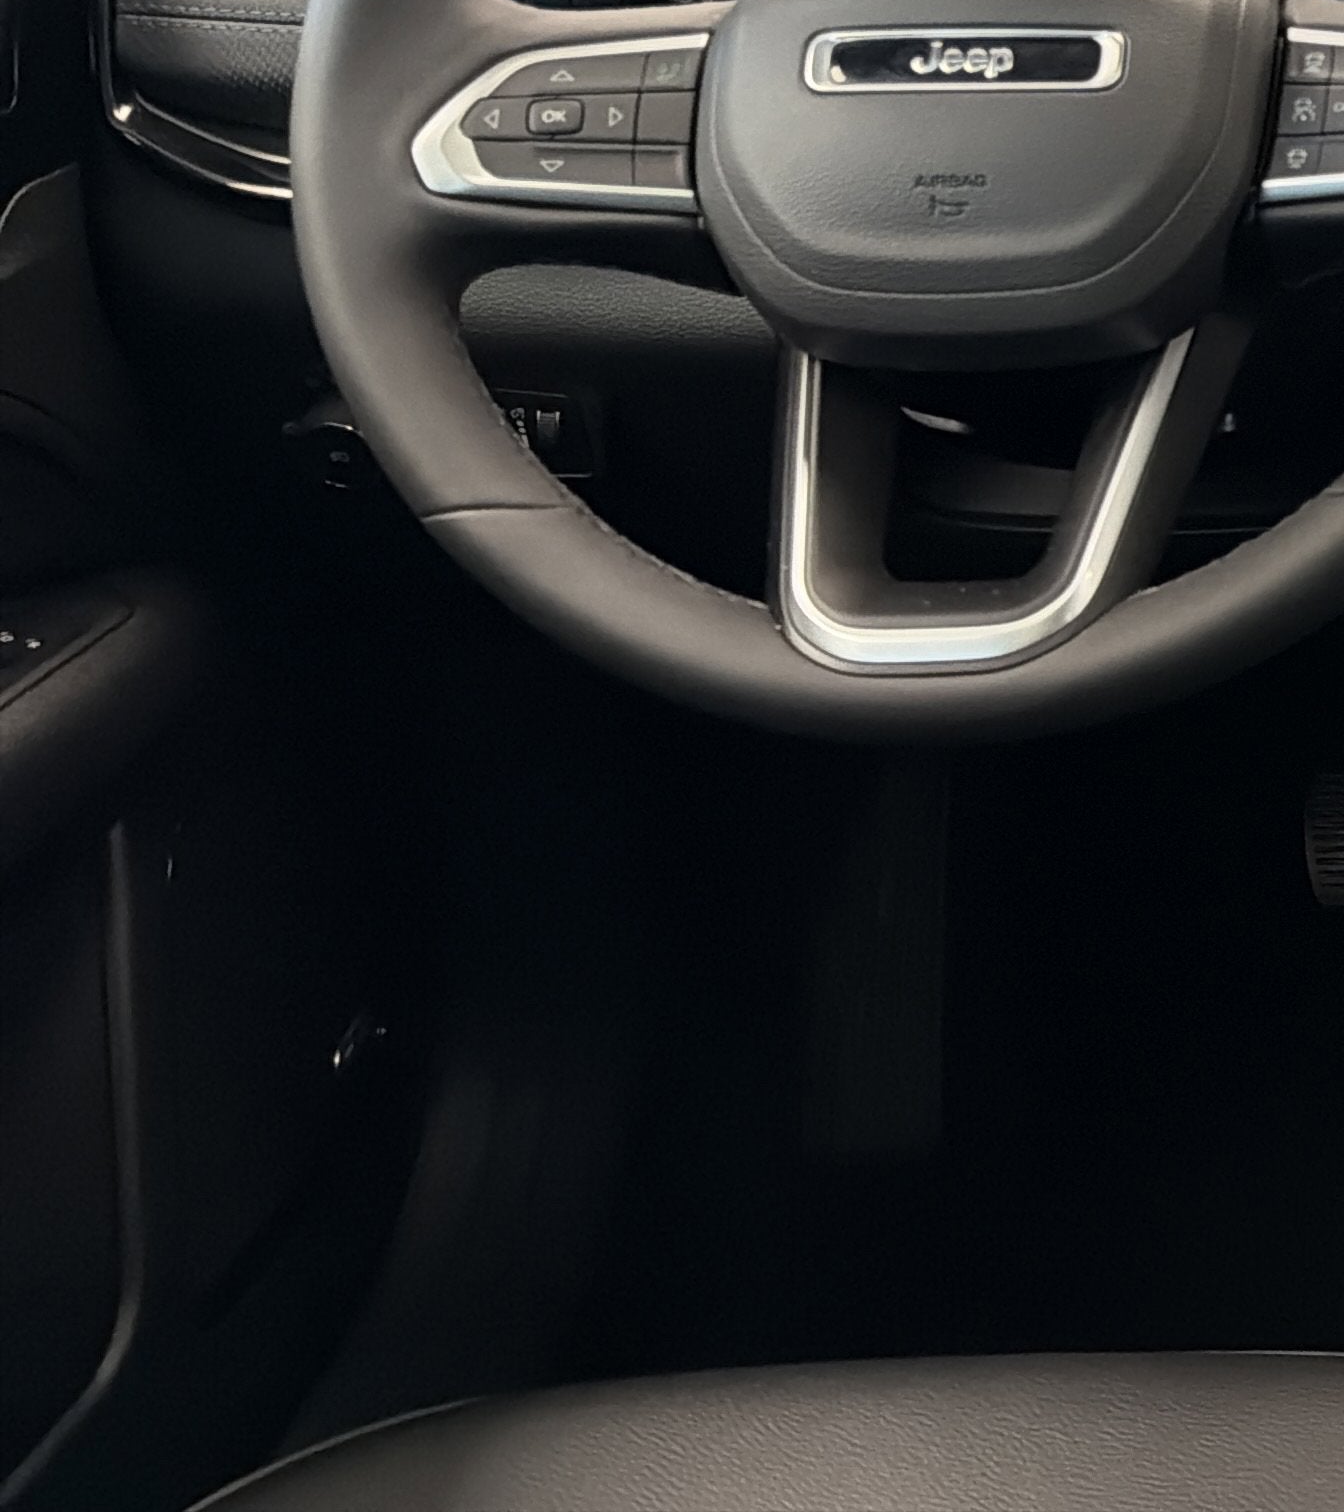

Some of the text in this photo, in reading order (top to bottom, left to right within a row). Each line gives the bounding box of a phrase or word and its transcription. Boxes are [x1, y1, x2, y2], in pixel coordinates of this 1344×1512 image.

[910, 40, 1014, 79] Jeep
[541, 109, 566, 123] OK
[914, 173, 987, 187] AIRBAG
